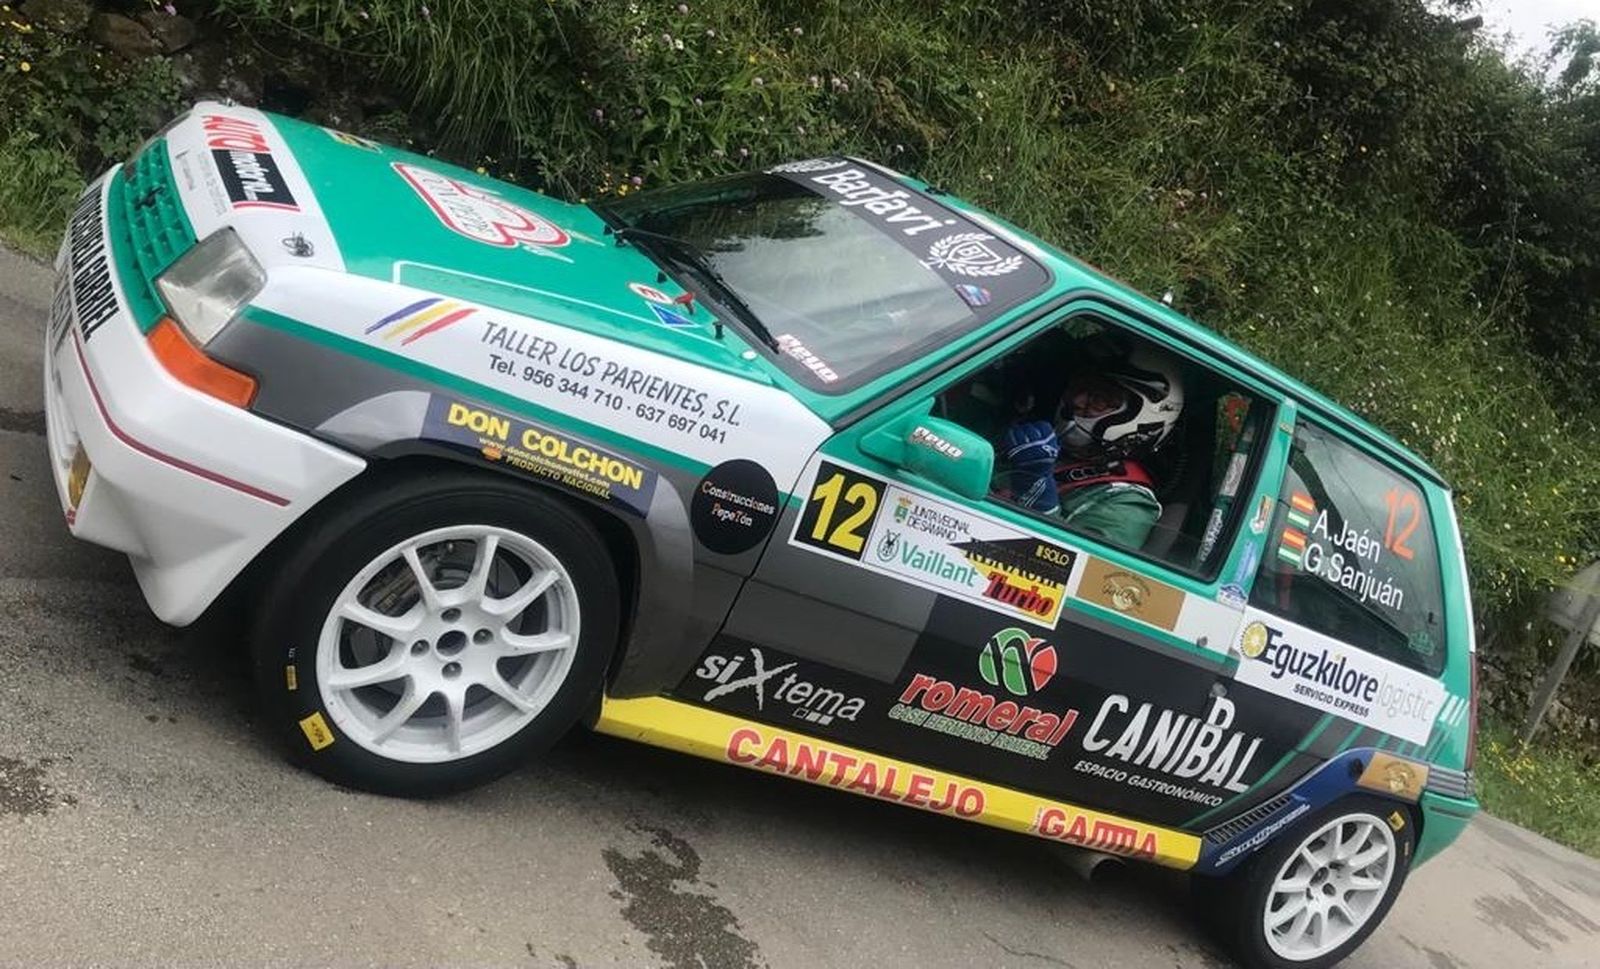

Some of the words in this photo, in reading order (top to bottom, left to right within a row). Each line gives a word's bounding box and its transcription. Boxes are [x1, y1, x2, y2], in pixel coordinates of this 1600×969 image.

[71, 183, 105, 276] ESCUELA
[73, 255, 120, 344] GABRIEL
[481, 321, 558, 365] TALLER
[558, 347, 600, 377] LOS
[600, 361, 708, 418] PARIENTES,
[711, 399, 741, 427] S.L.
[489, 354, 516, 377] Tel.
[522, 366, 555, 388] 956
[558, 378, 589, 399] 344
[593, 389, 624, 411] 710
[635, 403, 665, 423] 637
[667, 414, 697, 434] 697
[699, 424, 727, 444] 041
[447, 403, 511, 441] DON
[521, 428, 644, 491] COLCHON
[505, 455, 561, 481] PRODUCTO
[561, 475, 611, 500] NACIONAL
[702, 480, 775, 515] Construcciones
[810, 472, 878, 553] 12
[1383, 485, 1421, 560] 12
[901, 541, 978, 588] Vaillant
[1042, 546, 1070, 567] SOLO
[1312, 508, 1382, 564] A.Jaén
[982, 570, 1055, 617] Turbo
[1304, 542, 1404, 611] G.Sanjuán
[898, 671, 1080, 747] romeral
[1257, 625, 1379, 702] Eguzkilore
[1376, 671, 1436, 722] logistic
[1292, 682, 1334, 705] SERVICIO
[1333, 697, 1370, 719] EXPRESS
[888, 703, 930, 727] CASH
[922, 713, 998, 745] HERMANOS
[990, 732, 1053, 761] ROMERAL
[1081, 694, 1264, 793] CANIBAL
[726, 726, 988, 821] CANTALEJO
[1073, 760, 1127, 782] ESPACIO
[1127, 775, 1223, 807] GASTRONÓMICO
